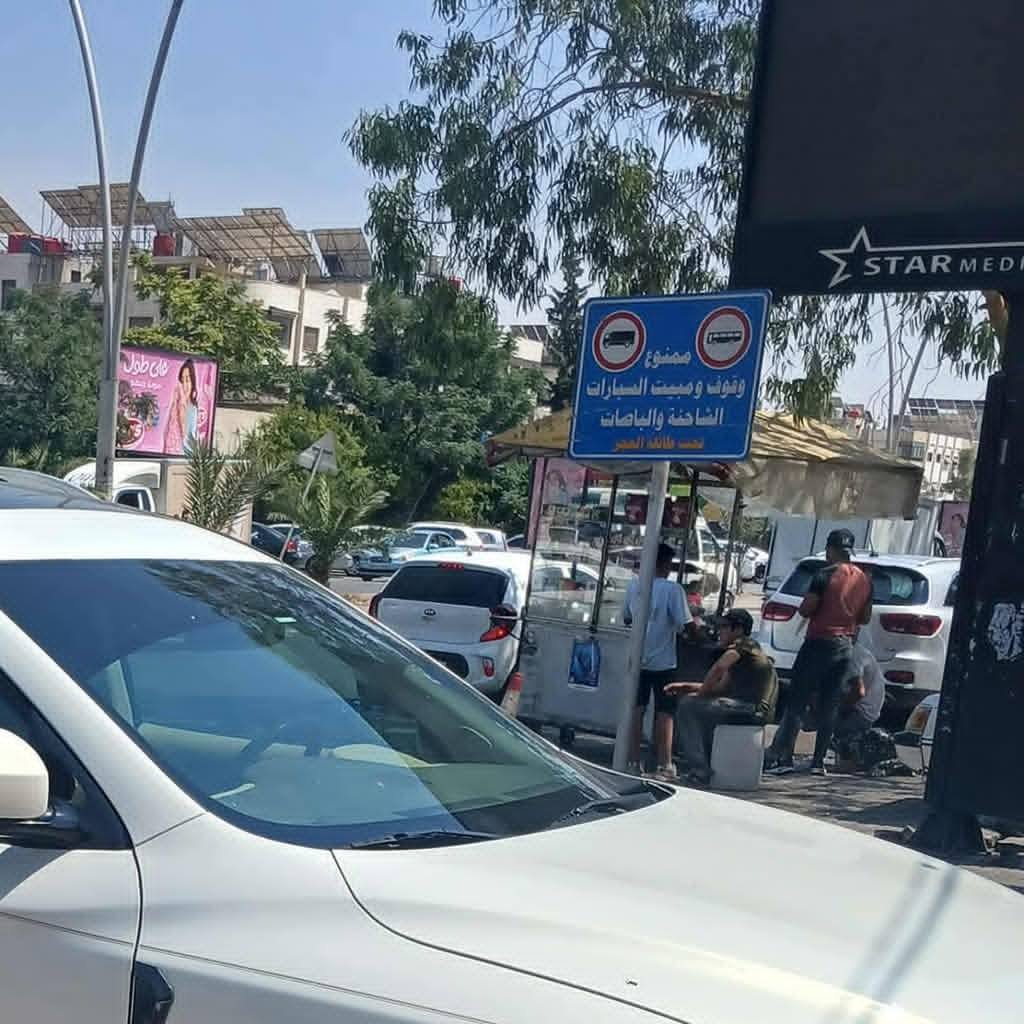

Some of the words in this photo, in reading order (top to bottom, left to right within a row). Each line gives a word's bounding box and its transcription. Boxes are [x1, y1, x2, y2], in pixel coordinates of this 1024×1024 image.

[863, 254, 952, 275] STAR
[123, 353, 150, 376] طول
[644, 346, 692, 368] ممنوع
[586, 376, 648, 400] السيارات
[650, 379, 704, 400] ومبيت
[706, 375, 746, 399] وقوف
[600, 407, 665, 431] والباصات
[667, 406, 724, 427] الشاحنة
